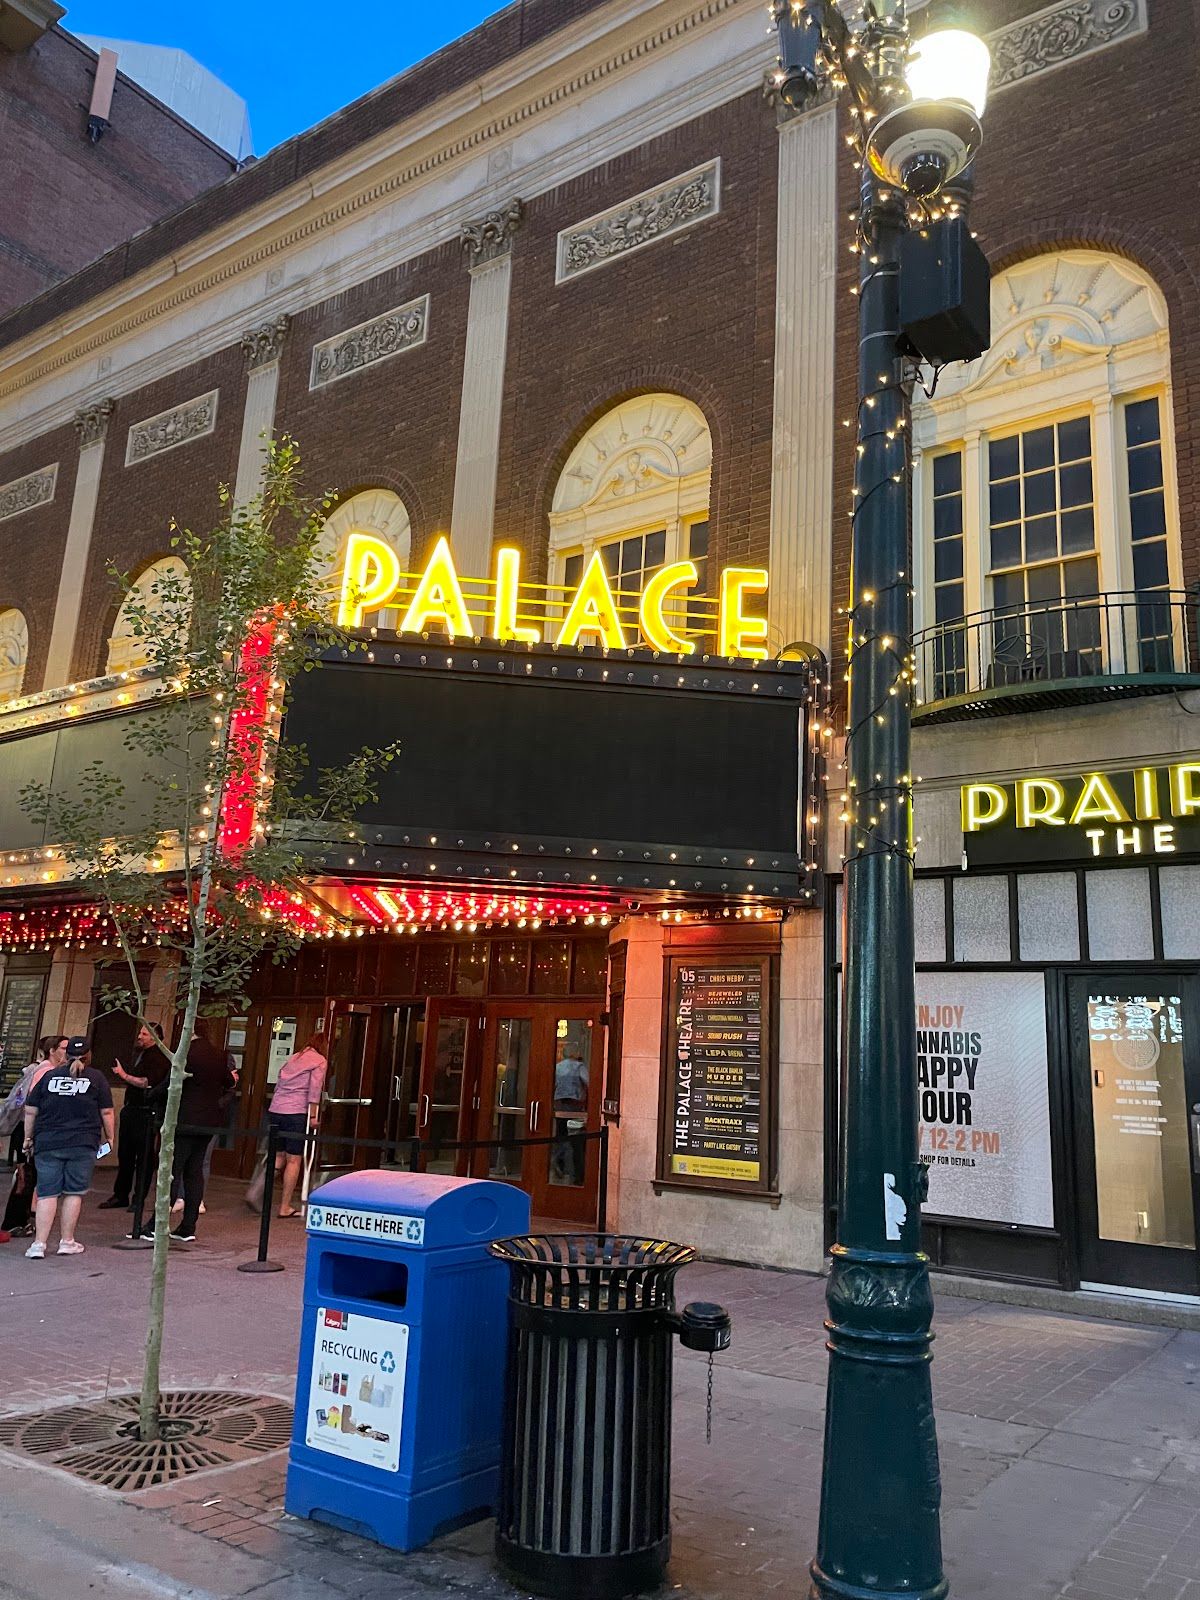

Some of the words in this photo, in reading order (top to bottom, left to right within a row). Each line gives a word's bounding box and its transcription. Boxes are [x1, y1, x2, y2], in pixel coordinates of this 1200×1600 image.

[337, 534, 769, 660] PALACE
[1086, 825, 1176, 857] THE
[682, 970, 696, 982] 05
[916, 1005, 965, 1028] NJOY
[705, 1049, 727, 1057] LEPA
[677, 1062, 692, 1116] PALACE
[919, 1090, 972, 1125] OUR
[704, 1116, 743, 1126] BACKTRAXX
[676, 1119, 688, 1148] THE
[972, 1130, 1000, 1154] PM
[920, 1154, 936, 1163] SHOP
[938, 1156, 949, 1165] FOR
[325, 1212, 372, 1231] RECYCLE
[374, 1218, 404, 1235] HERE
[321, 1340, 378, 1364] RECYCLING
